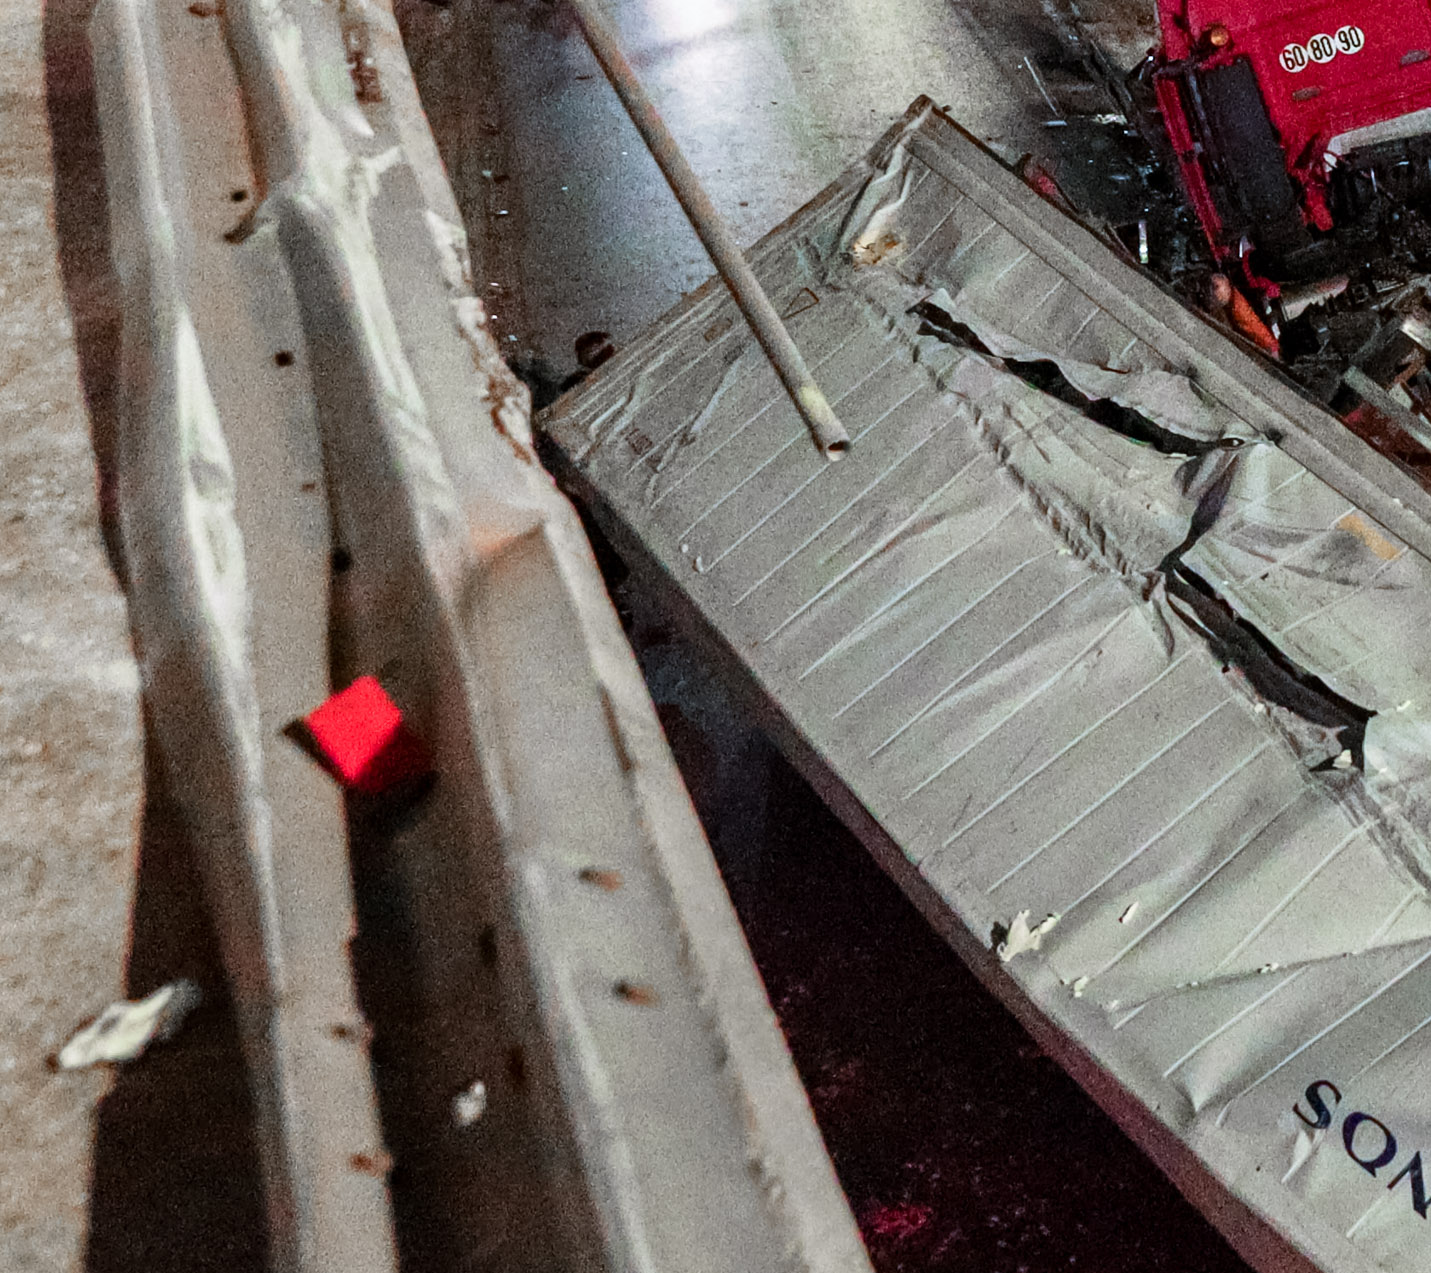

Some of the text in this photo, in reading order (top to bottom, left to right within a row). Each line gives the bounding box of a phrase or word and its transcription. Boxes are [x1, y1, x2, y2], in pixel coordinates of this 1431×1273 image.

[1283, 27, 1361, 70] 60 80 90
